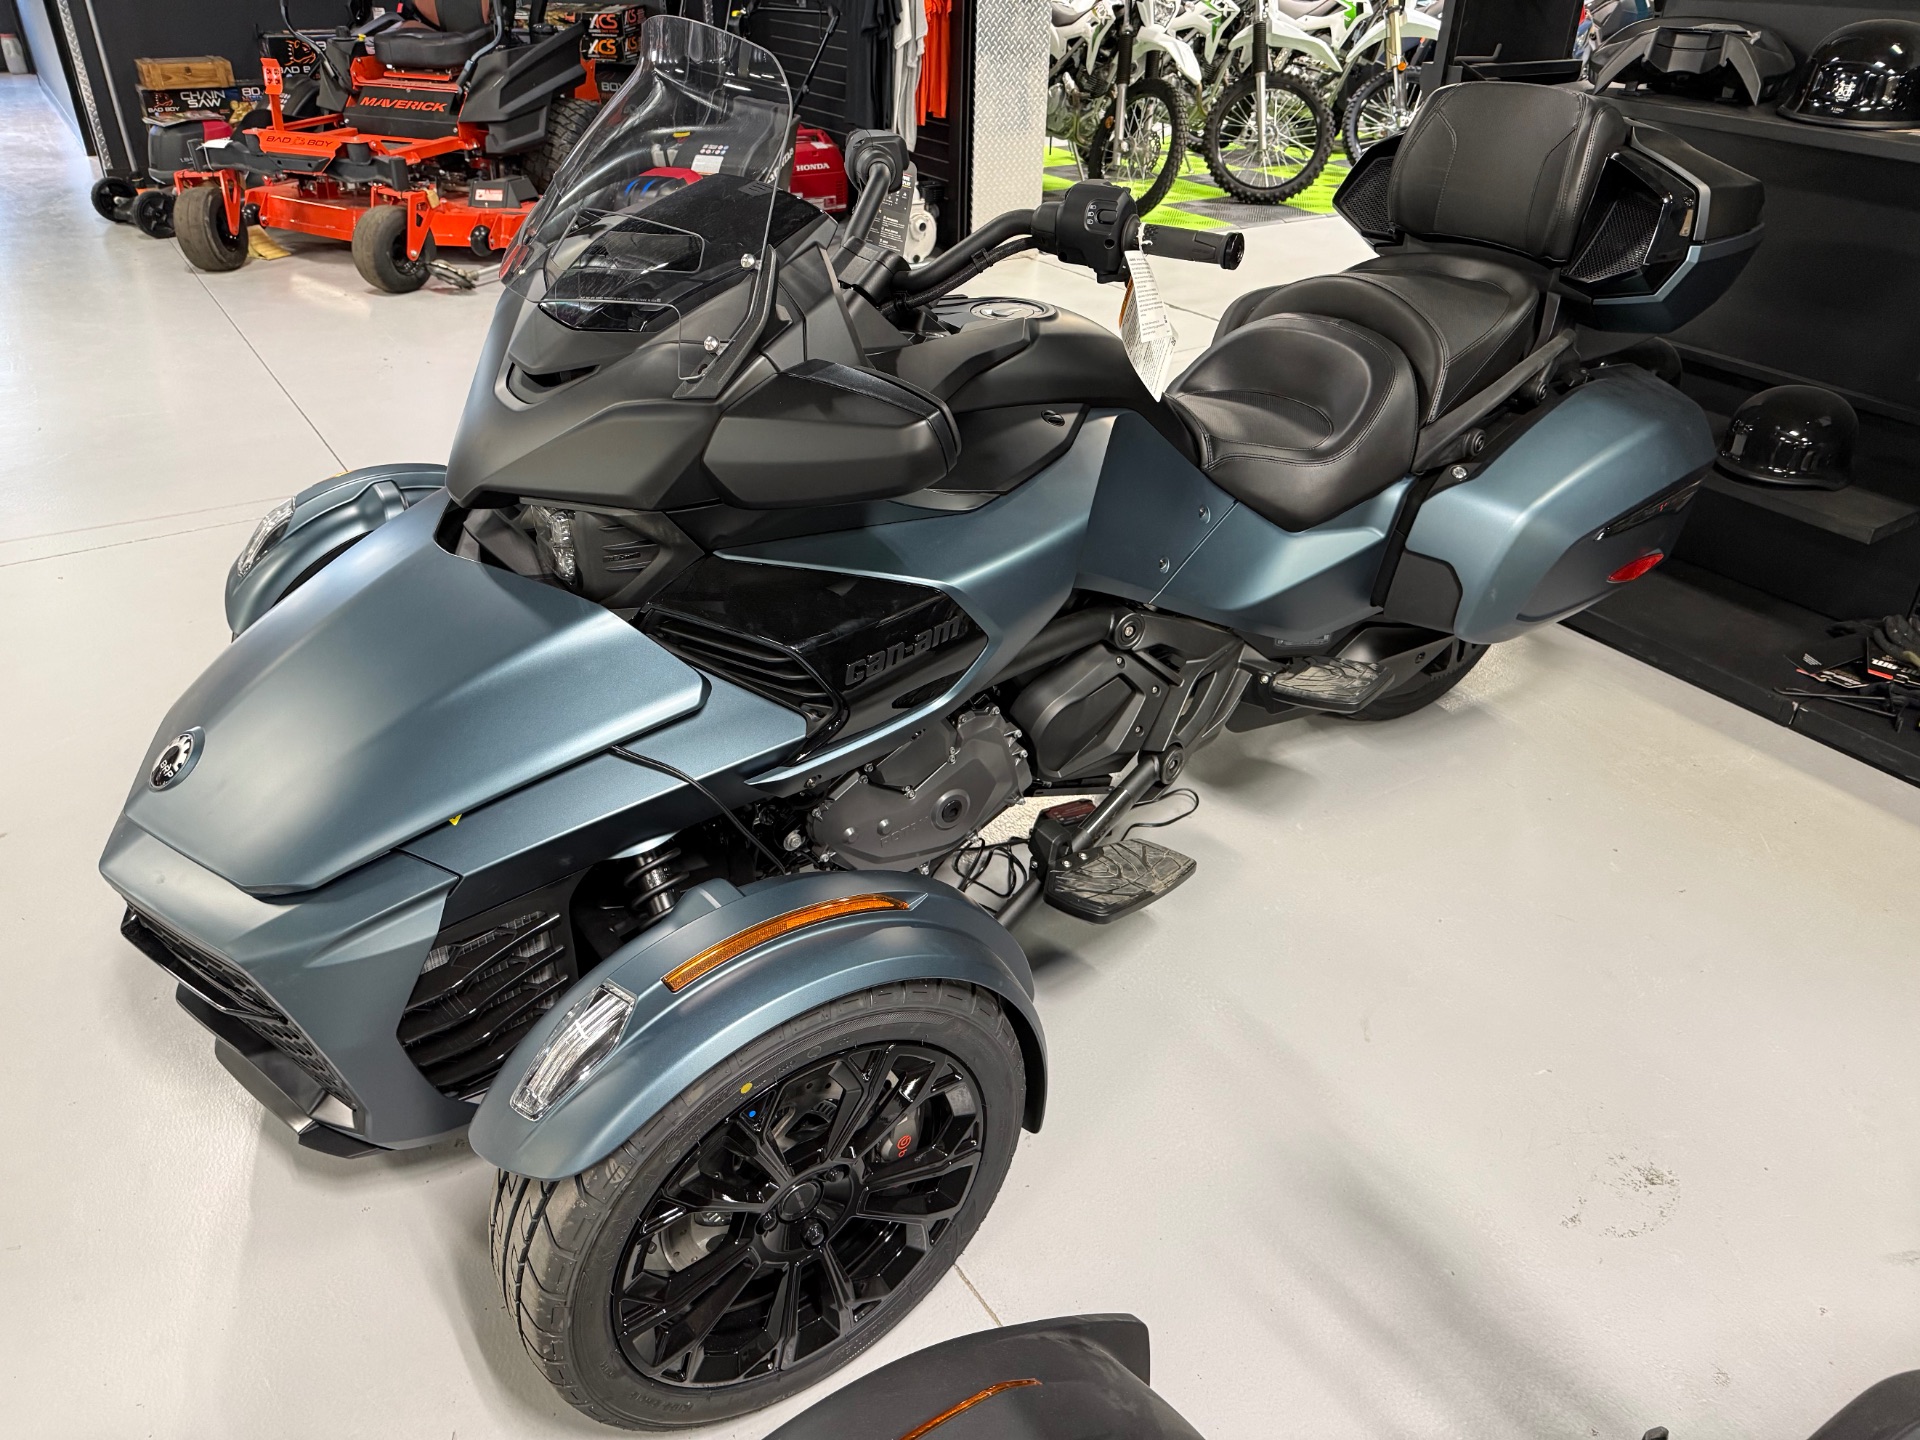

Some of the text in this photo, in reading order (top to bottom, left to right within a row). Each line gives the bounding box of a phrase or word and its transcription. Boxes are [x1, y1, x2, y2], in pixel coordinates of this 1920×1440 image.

[180, 90, 226, 101] CHAIN
[188, 99, 221, 109] SAW
[360, 96, 447, 113] MAVERICK
[266, 136, 333, 147] BAD BOY
[796, 162, 830, 172] HONDA
[160, 759, 174, 778] BRP
